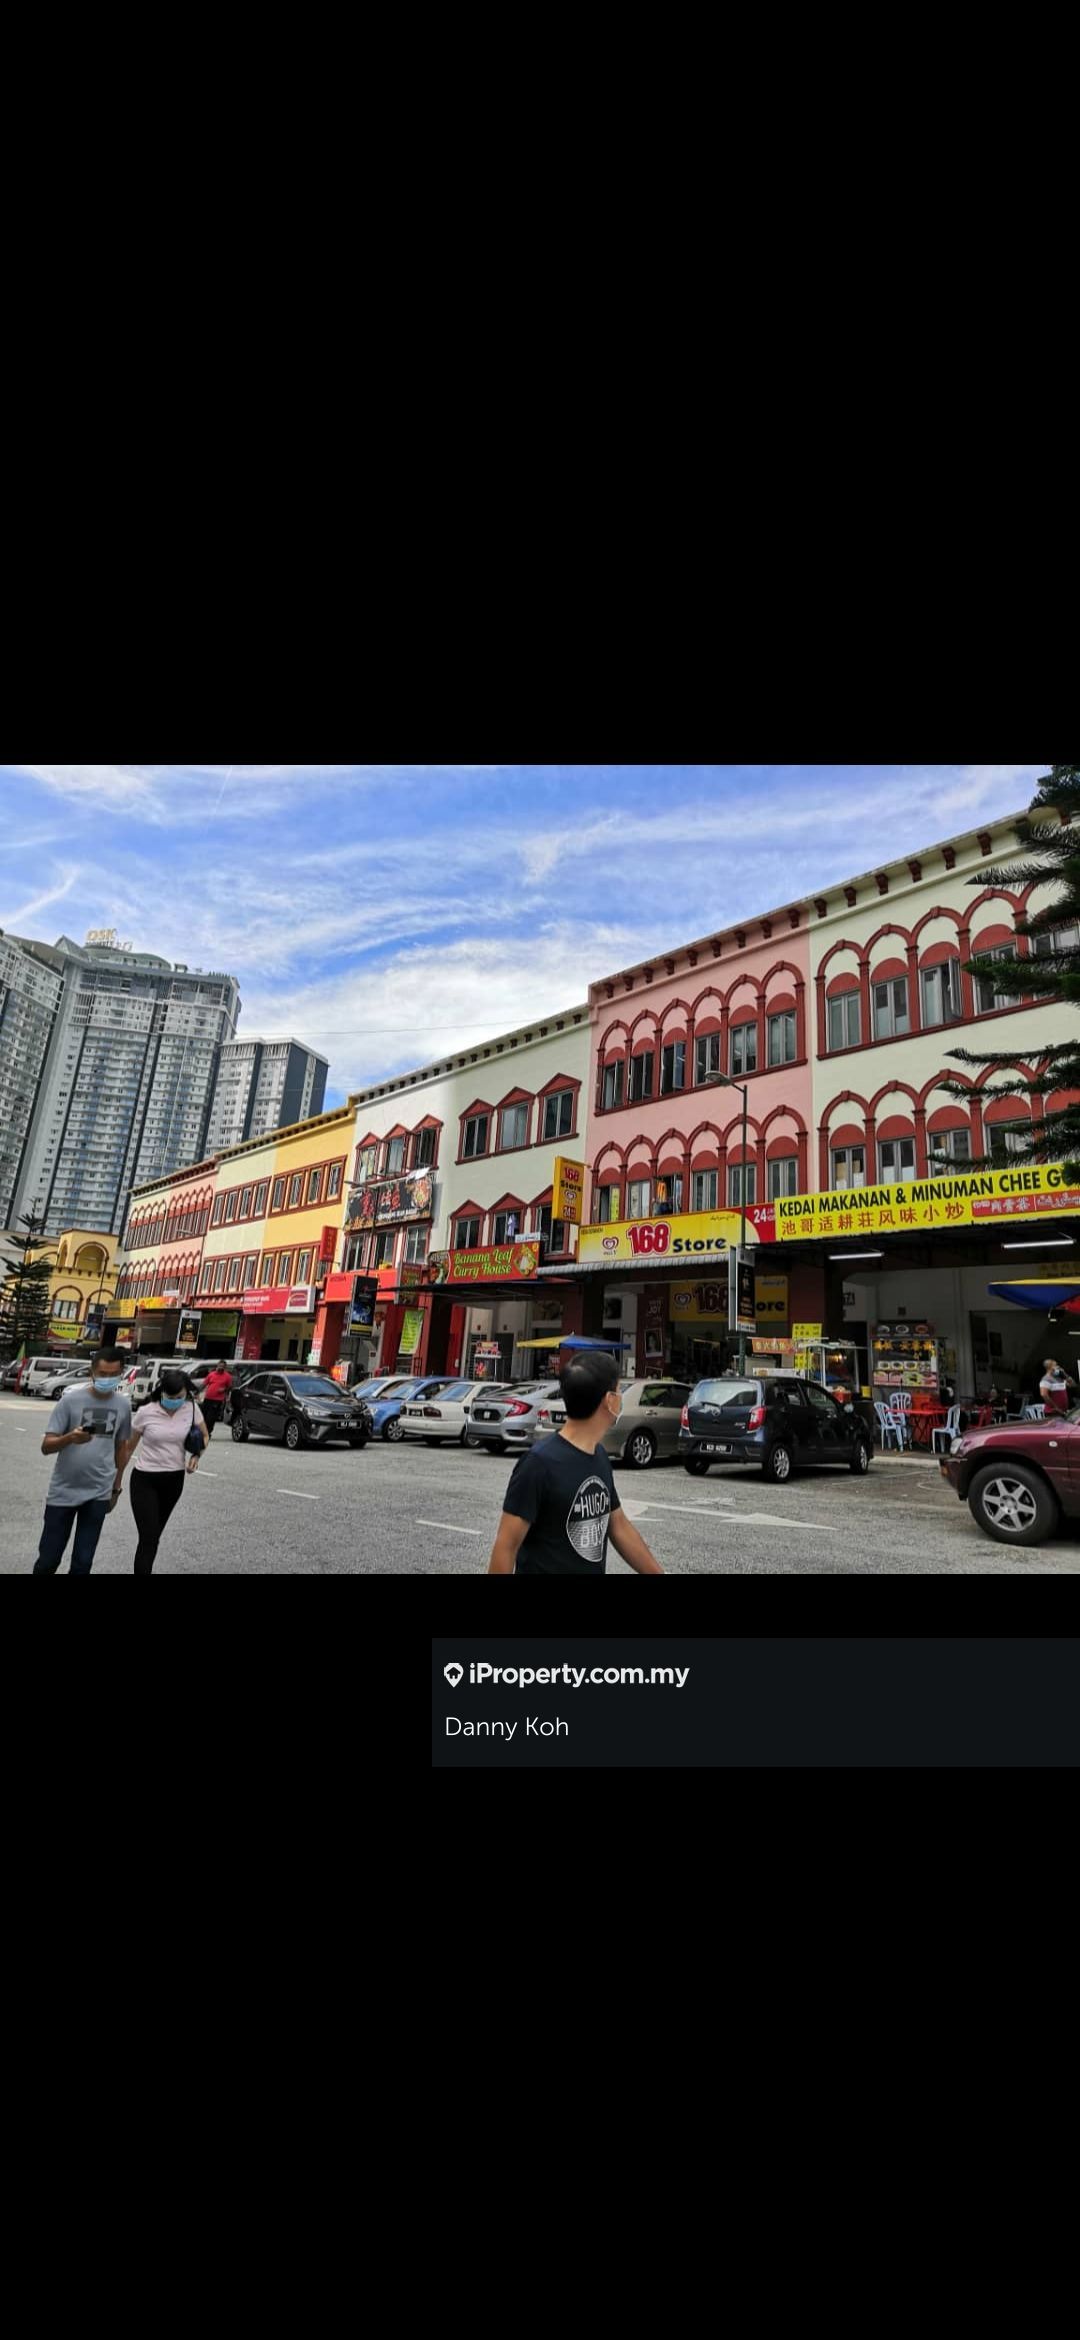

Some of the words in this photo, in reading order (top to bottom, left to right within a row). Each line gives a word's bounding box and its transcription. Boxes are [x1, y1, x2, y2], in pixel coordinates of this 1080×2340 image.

[779, 1198, 815, 1217] KEDAI
[819, 1189, 891, 1213] MAKANAN
[896, 1187, 906, 1204] &
[912, 1177, 994, 1203] MINUMAN
[998, 1171, 1042, 1192] CHEE
[753, 1208, 767, 1224] 24
[626, 1221, 671, 1257] 168
[672, 1238, 727, 1254] Store
[454, 1252, 490, 1265] Banana
[493, 1247, 515, 1264] Leaf
[453, 1265, 480, 1279] Curry
[482, 1262, 512, 1275] House
[756, 1301, 785, 1312] ore
[581, 1491, 606, 1518] HUGO
